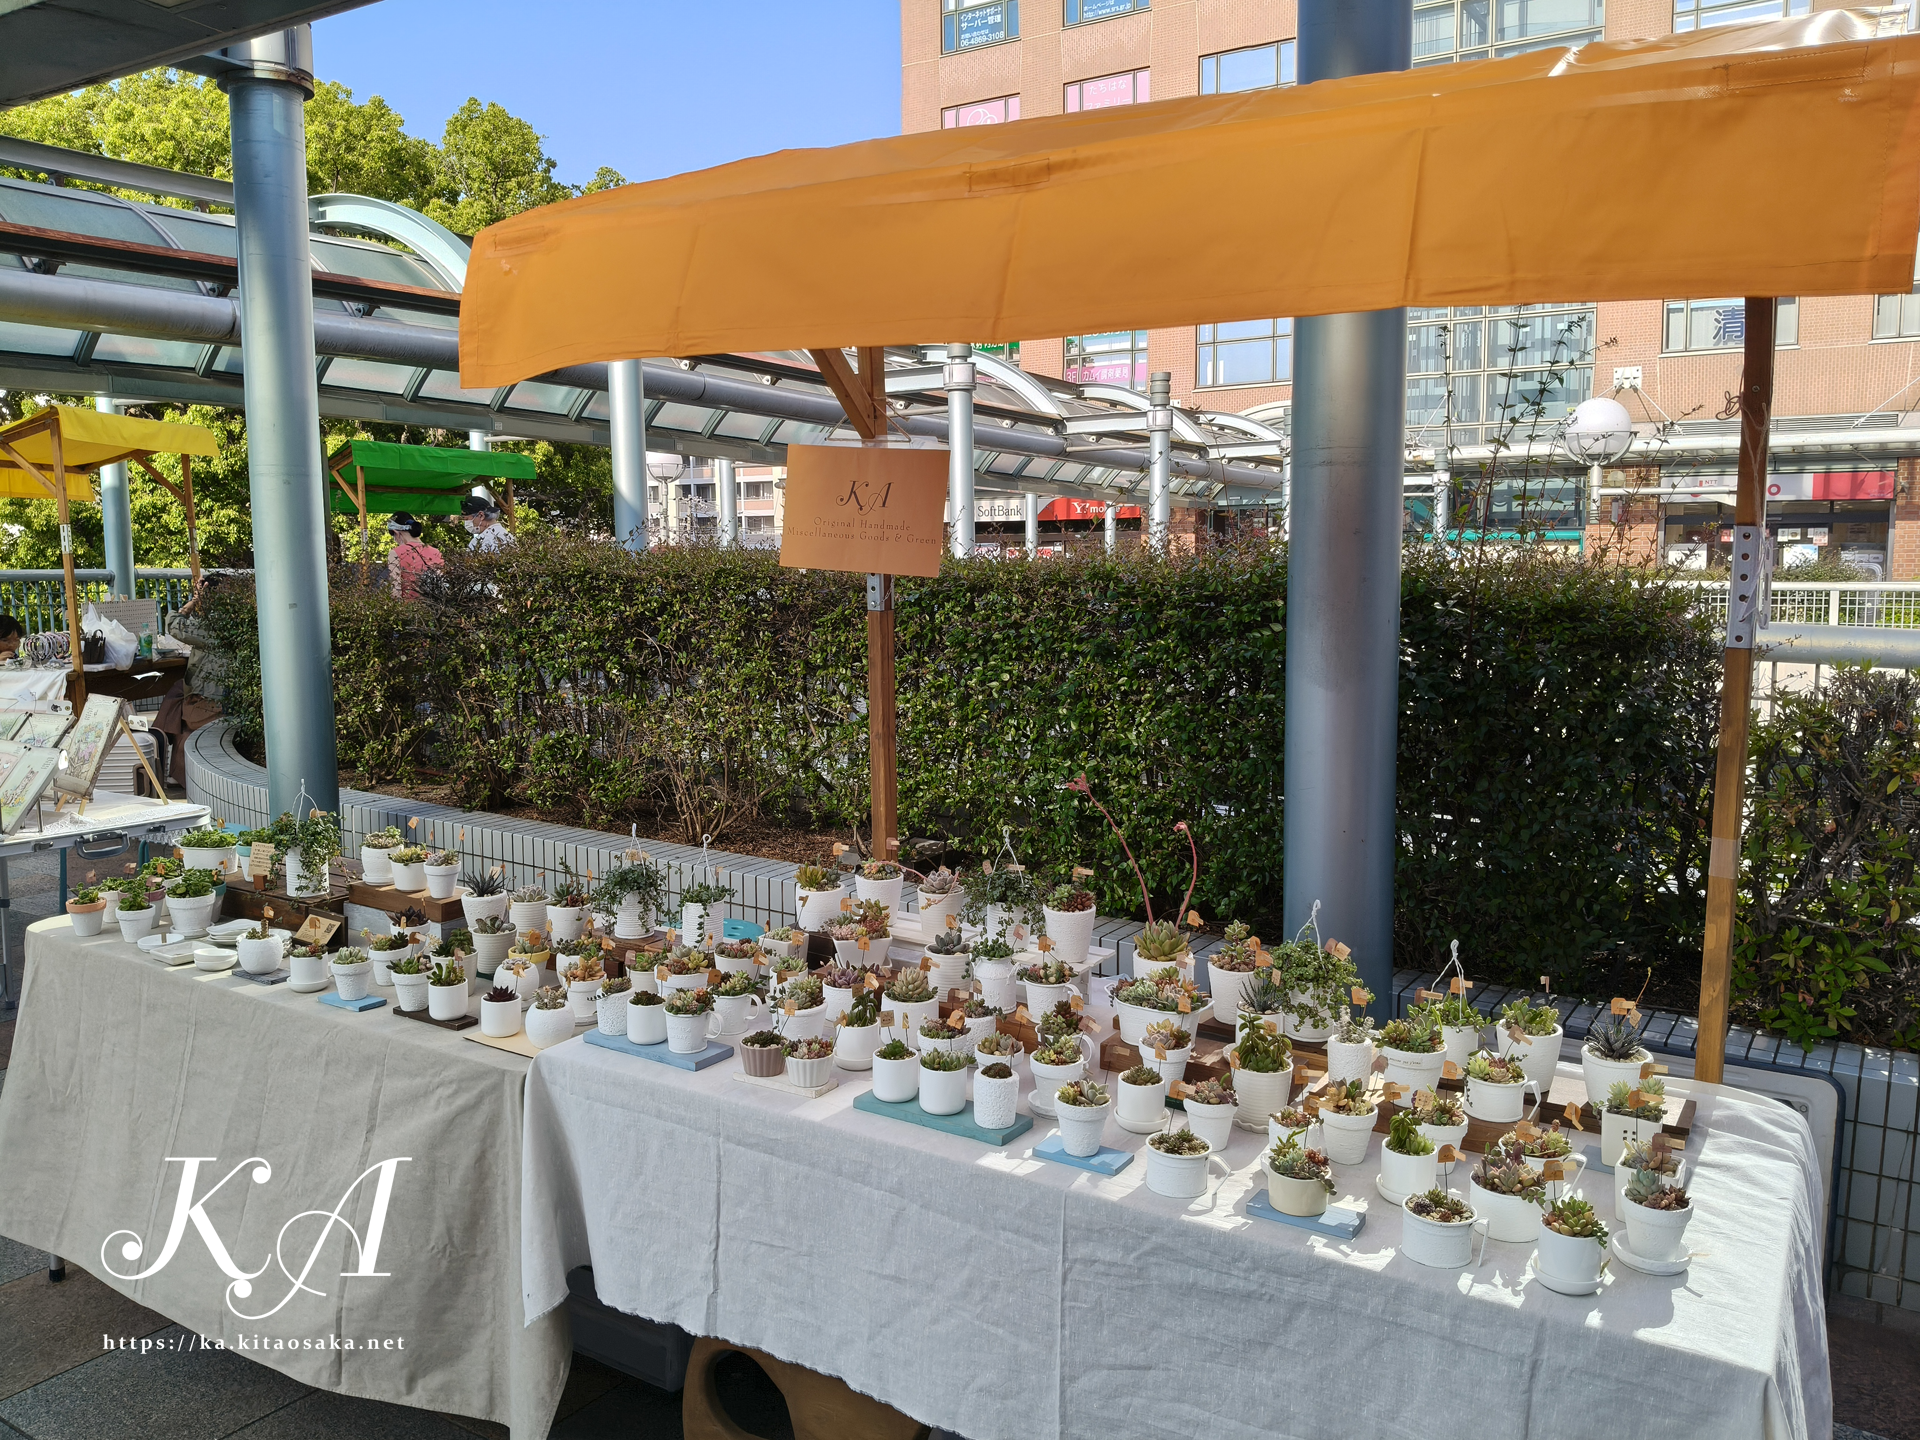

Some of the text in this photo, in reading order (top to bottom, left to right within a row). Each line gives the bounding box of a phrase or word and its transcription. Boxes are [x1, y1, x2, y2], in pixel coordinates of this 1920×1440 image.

[961, 15, 1001, 30] サーバー管理
[836, 480, 894, 516] KA
[977, 504, 1022, 518] SoftBank
[814, 517, 911, 531] Original Handmade
[787, 526, 936, 545] Miscellaneous Goods & Green
